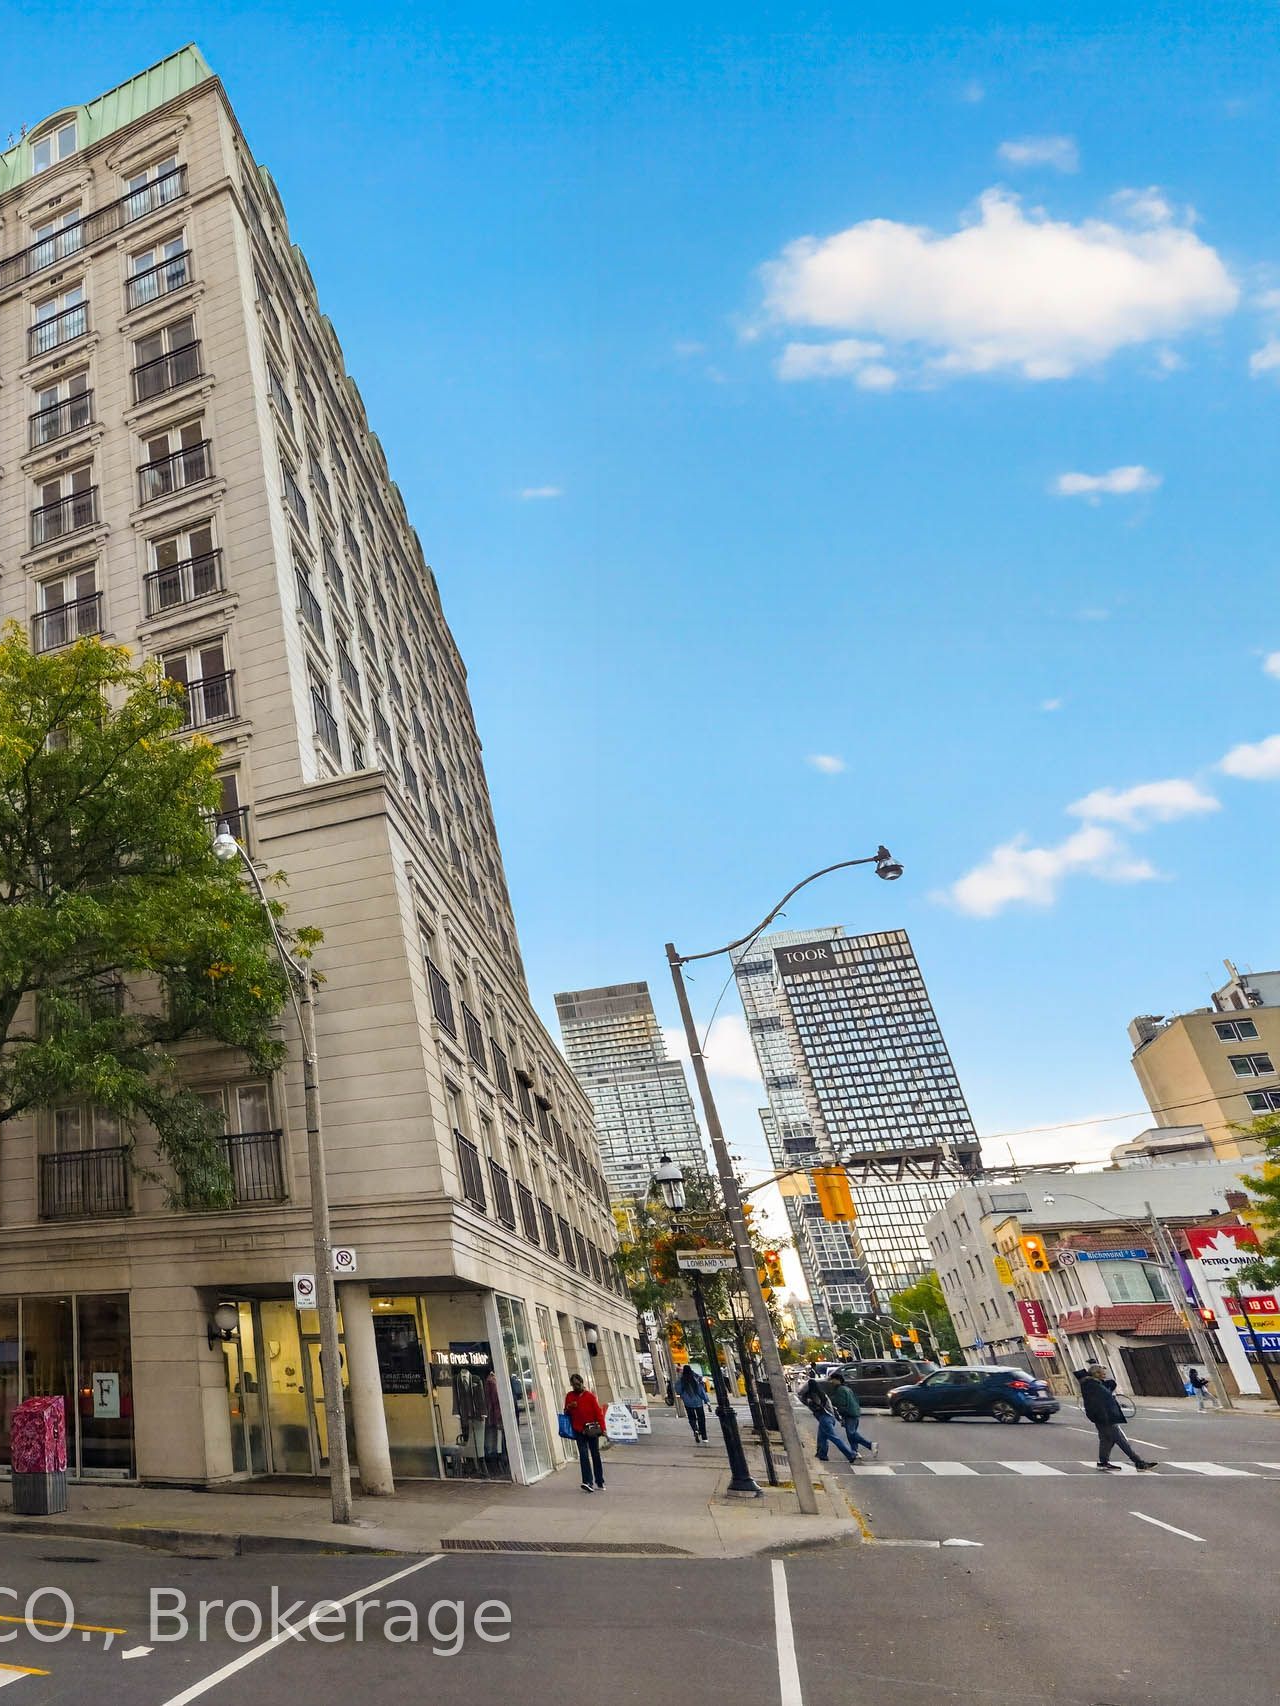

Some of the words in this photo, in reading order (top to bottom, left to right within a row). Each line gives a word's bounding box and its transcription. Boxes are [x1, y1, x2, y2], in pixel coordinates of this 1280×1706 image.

[784, 948, 828, 964] TOOR
[1025, 1302, 1040, 1334] HOTEL
[1261, 1337, 1280, 1348] AT
[436, 1352, 449, 1364] The
[450, 1352, 468, 1364] Great
[469, 1352, 489, 1364] Tailor
[96, 1379, 114, 1407] F
